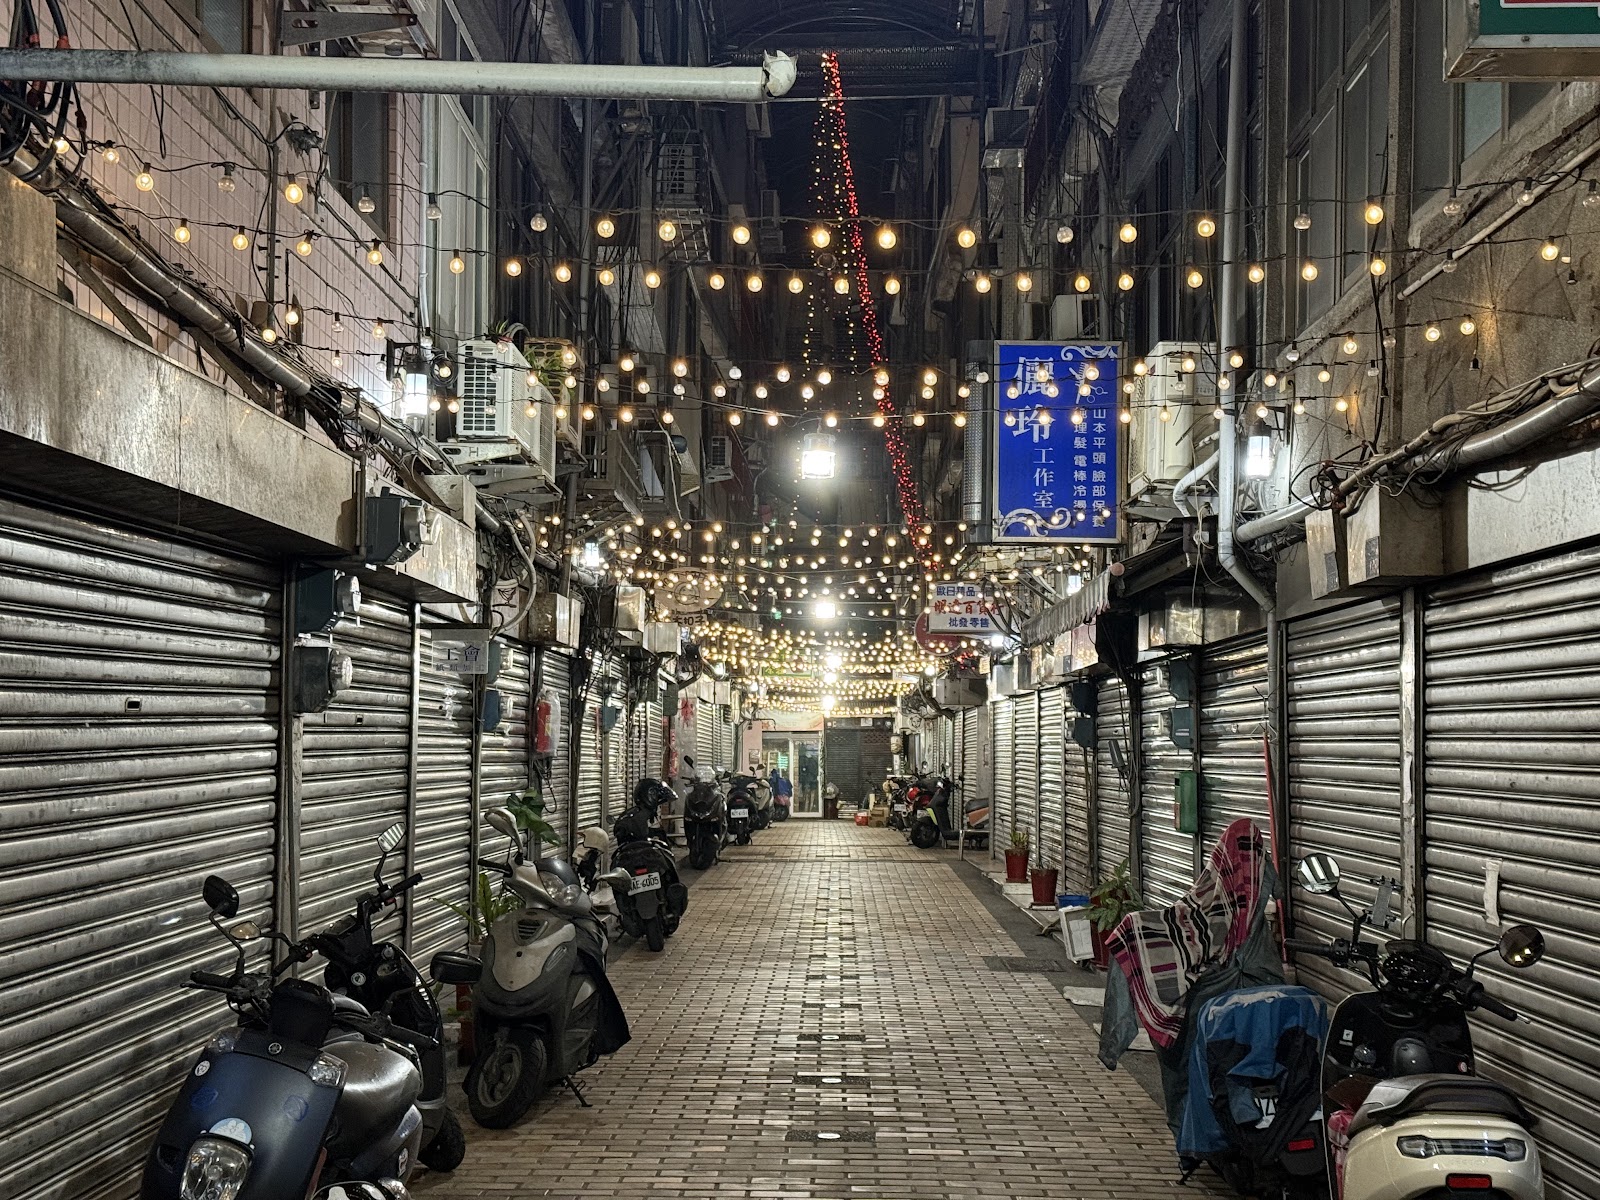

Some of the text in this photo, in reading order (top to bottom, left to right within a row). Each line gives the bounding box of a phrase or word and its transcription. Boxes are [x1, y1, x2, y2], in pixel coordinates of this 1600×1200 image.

[1033, 448, 1055, 509] 工作室
[949, 617, 990, 628] 批發零售
[630, 877, 660, 891] AE-6005
